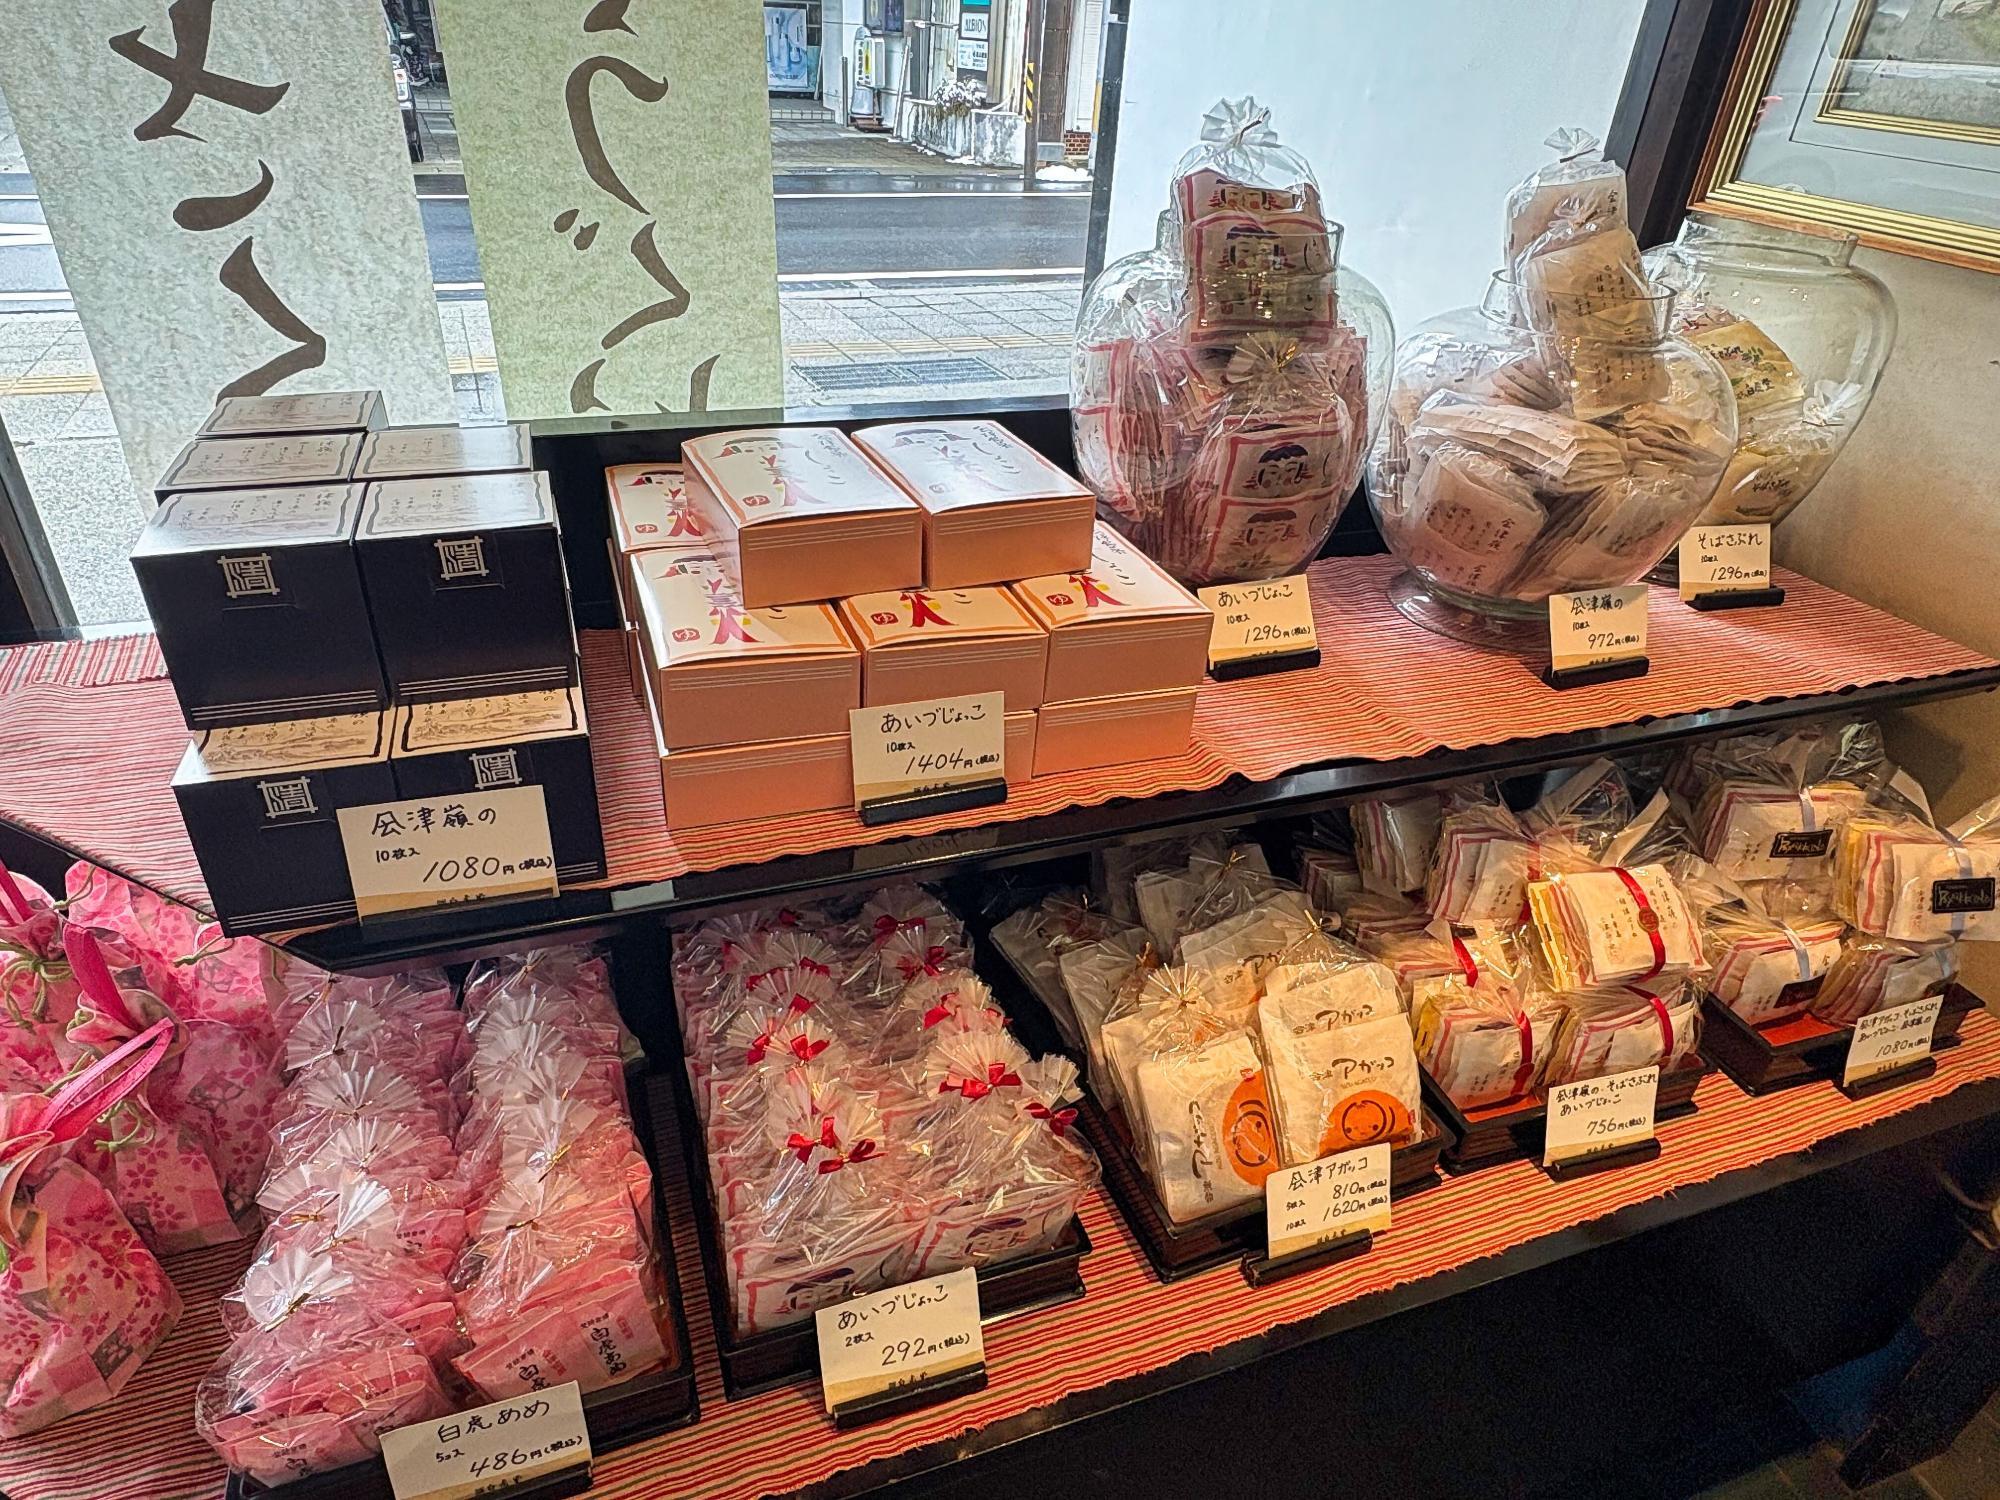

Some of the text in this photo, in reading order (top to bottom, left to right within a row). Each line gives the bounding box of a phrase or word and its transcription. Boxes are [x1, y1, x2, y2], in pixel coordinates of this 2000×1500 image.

[1698, 532, 1763, 549] そばさぶれ
[1218, 584, 1293, 607] あいづじょっこ
[1226, 613, 1250, 624] 10枚入
[881, 704, 986, 734] あいづじょっこ
[886, 742, 916, 754] 10枚入
[371, 803, 497, 838] 会津嶺の
[376, 847, 421, 863] 10枚入
[1560, 1094, 1622, 1117] あいづじょっこ
[1288, 1157, 1368, 1191] 会津アガッコ
[838, 1284, 948, 1330] あいづじょっこ
[845, 1331, 874, 1347] 2枚入
[438, 1399, 550, 1443] 白虎あめ
